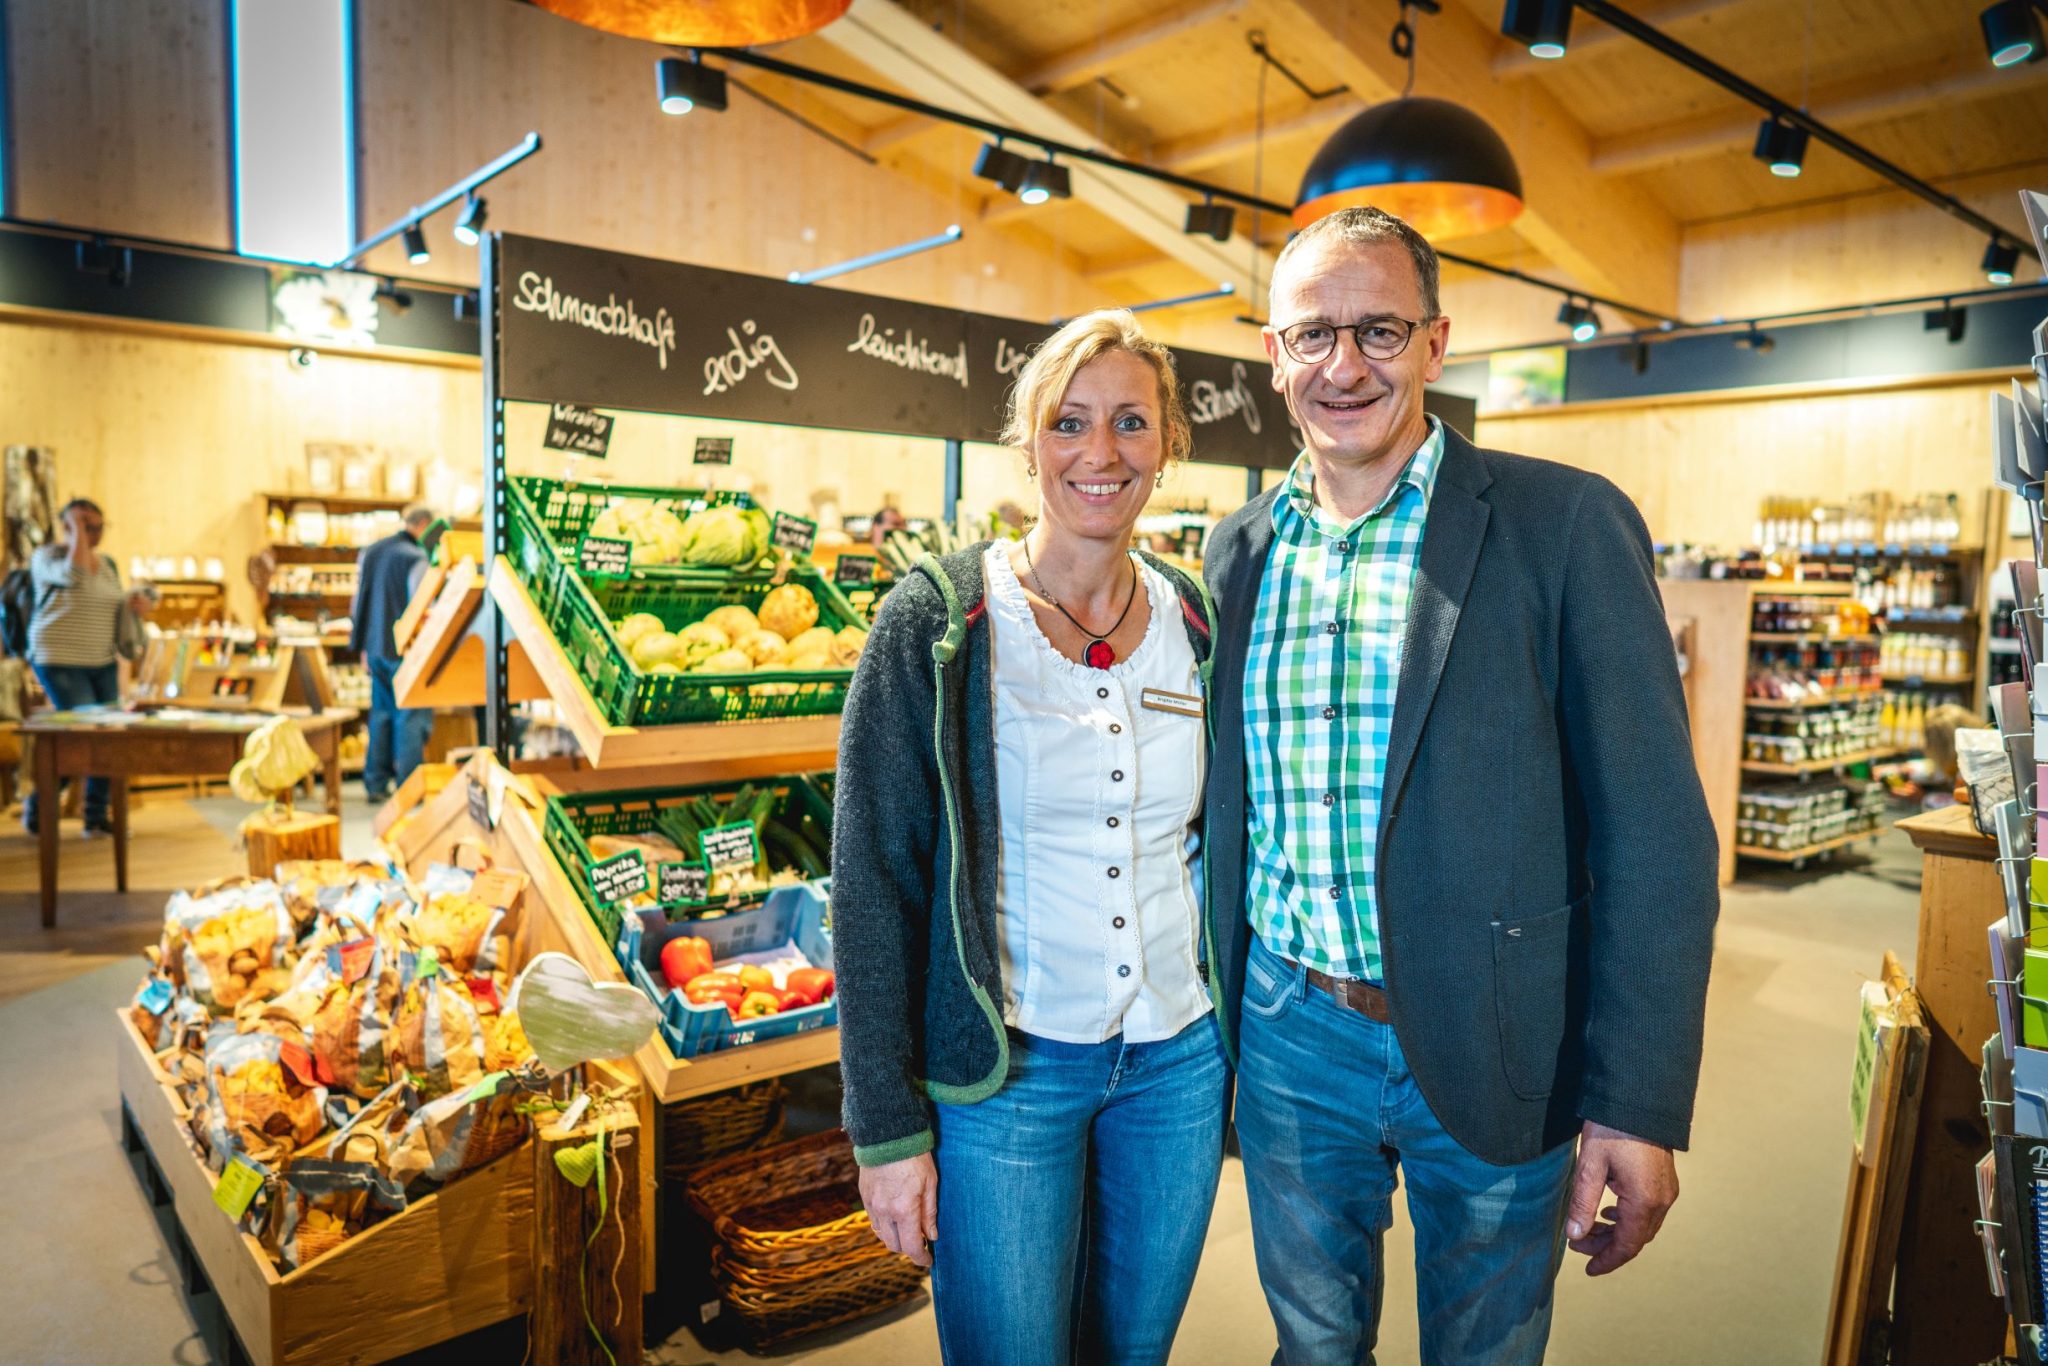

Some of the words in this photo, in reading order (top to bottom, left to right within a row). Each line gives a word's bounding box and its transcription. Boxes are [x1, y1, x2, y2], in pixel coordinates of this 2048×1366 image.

[513, 271, 676, 370] Schmackhaft
[703, 319, 798, 395] erdig
[592, 858, 638, 882] Paprika
